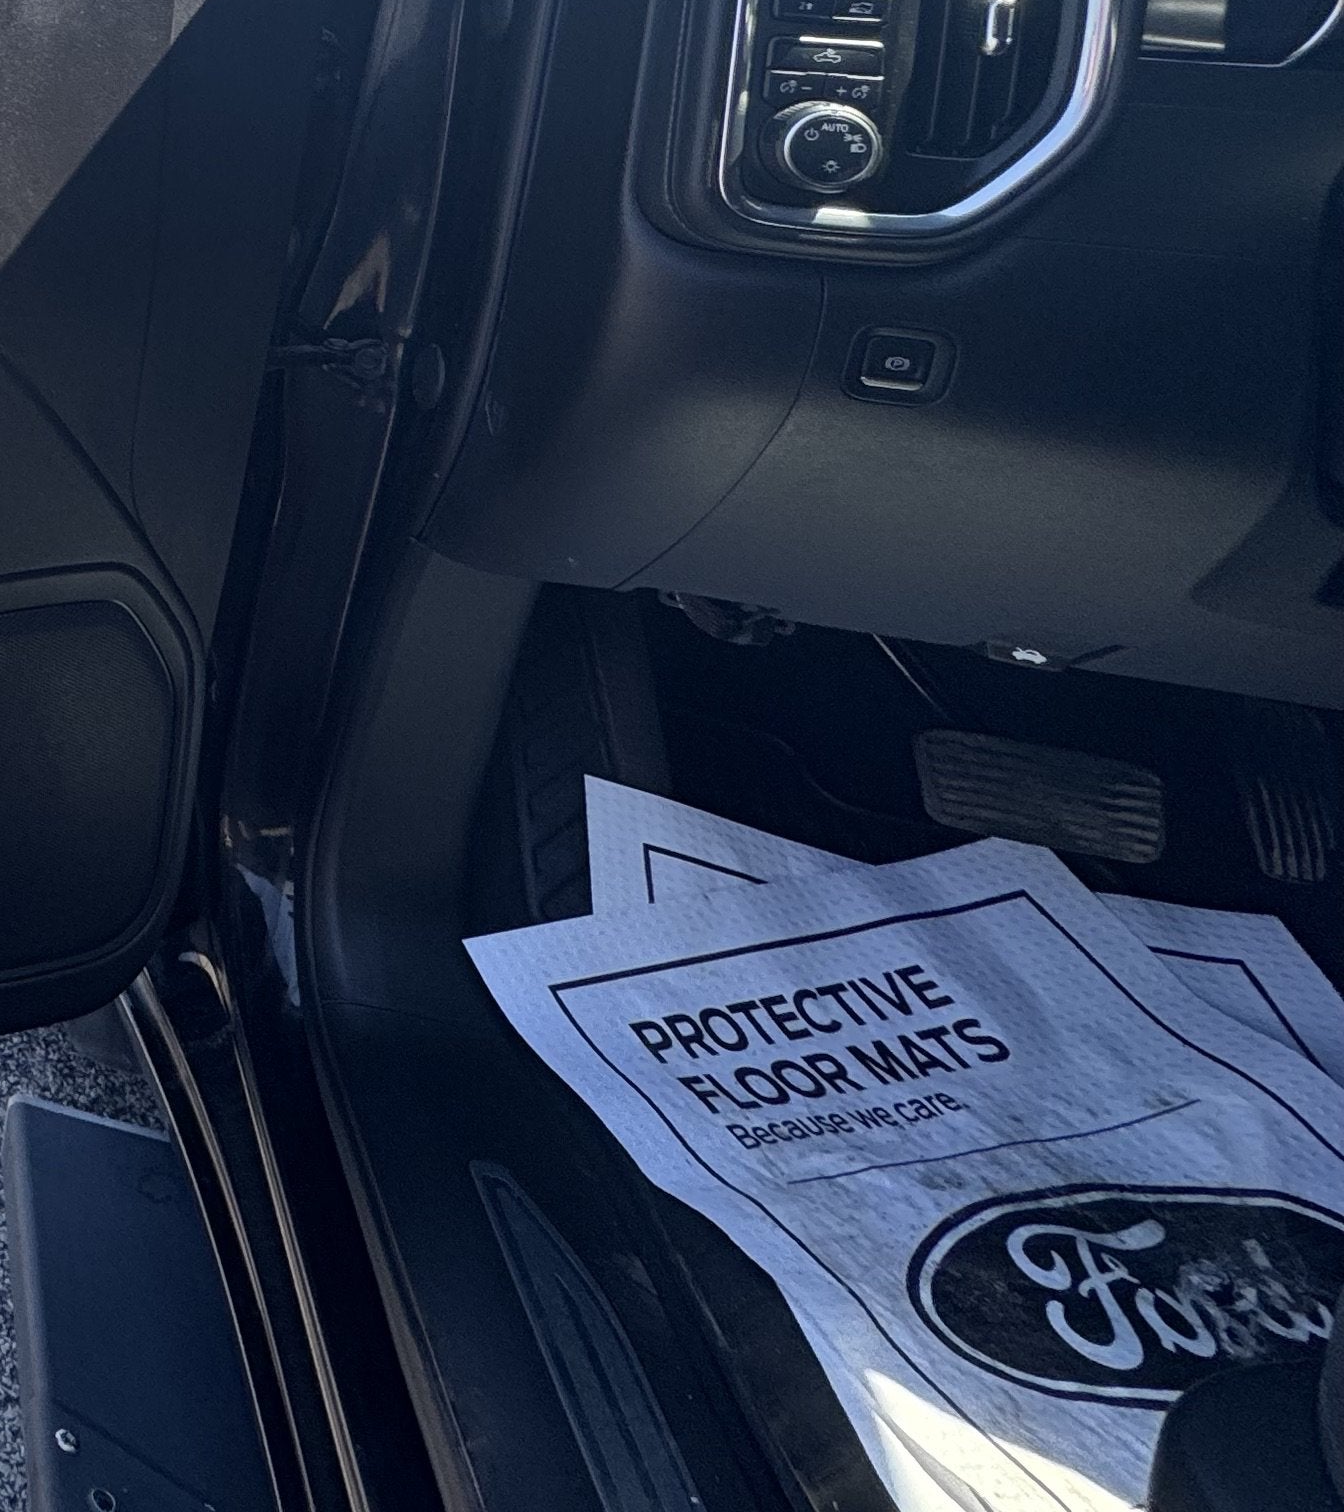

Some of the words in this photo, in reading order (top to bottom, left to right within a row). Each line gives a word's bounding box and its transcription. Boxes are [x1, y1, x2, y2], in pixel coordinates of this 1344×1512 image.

[821, 123, 849, 133] AUTO
[628, 964, 955, 1064] PROTECTIVE
[677, 1052, 868, 1114] FLOOR
[845, 1017, 1011, 1086] MATS
[726, 1111, 852, 1150] Because
[850, 1101, 900, 1130] we
[894, 1091, 971, 1124] care.
[1006, 1219, 1335, 1371] Ford
